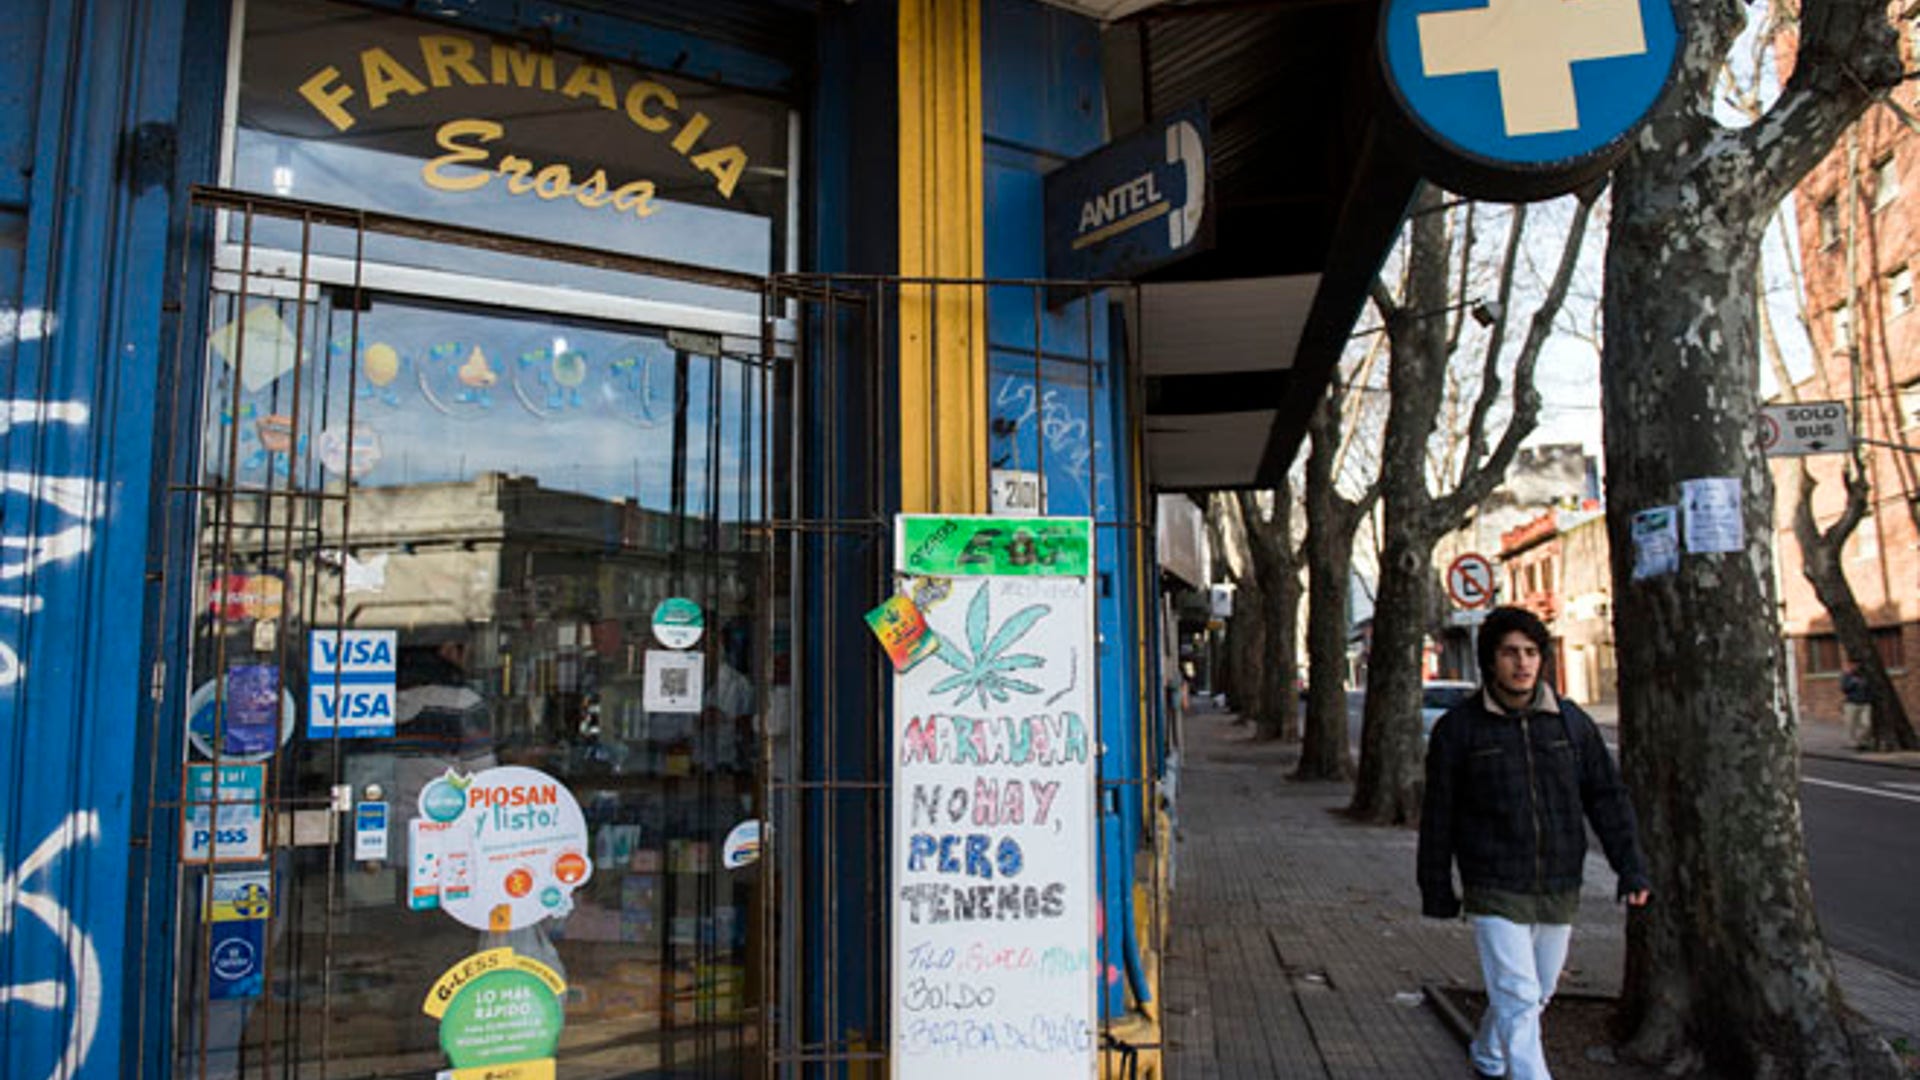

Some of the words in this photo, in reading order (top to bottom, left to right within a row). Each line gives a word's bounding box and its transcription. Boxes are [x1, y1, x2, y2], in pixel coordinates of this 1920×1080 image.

[300, 34, 748, 198] FARMACIA
[420, 118, 658, 217] Erosa
[1078, 172, 1162, 233] ANTEL
[1785, 407, 1839, 422] SOLO
[1794, 424, 1835, 439] BUS
[318, 639, 392, 664] VISA
[317, 692, 391, 718] VISA
[468, 784, 558, 808] PIOSAN
[907, 833, 1023, 878] PERO
[901, 882, 1067, 925] TENEMOS
[903, 975, 996, 1012] BOLDO
